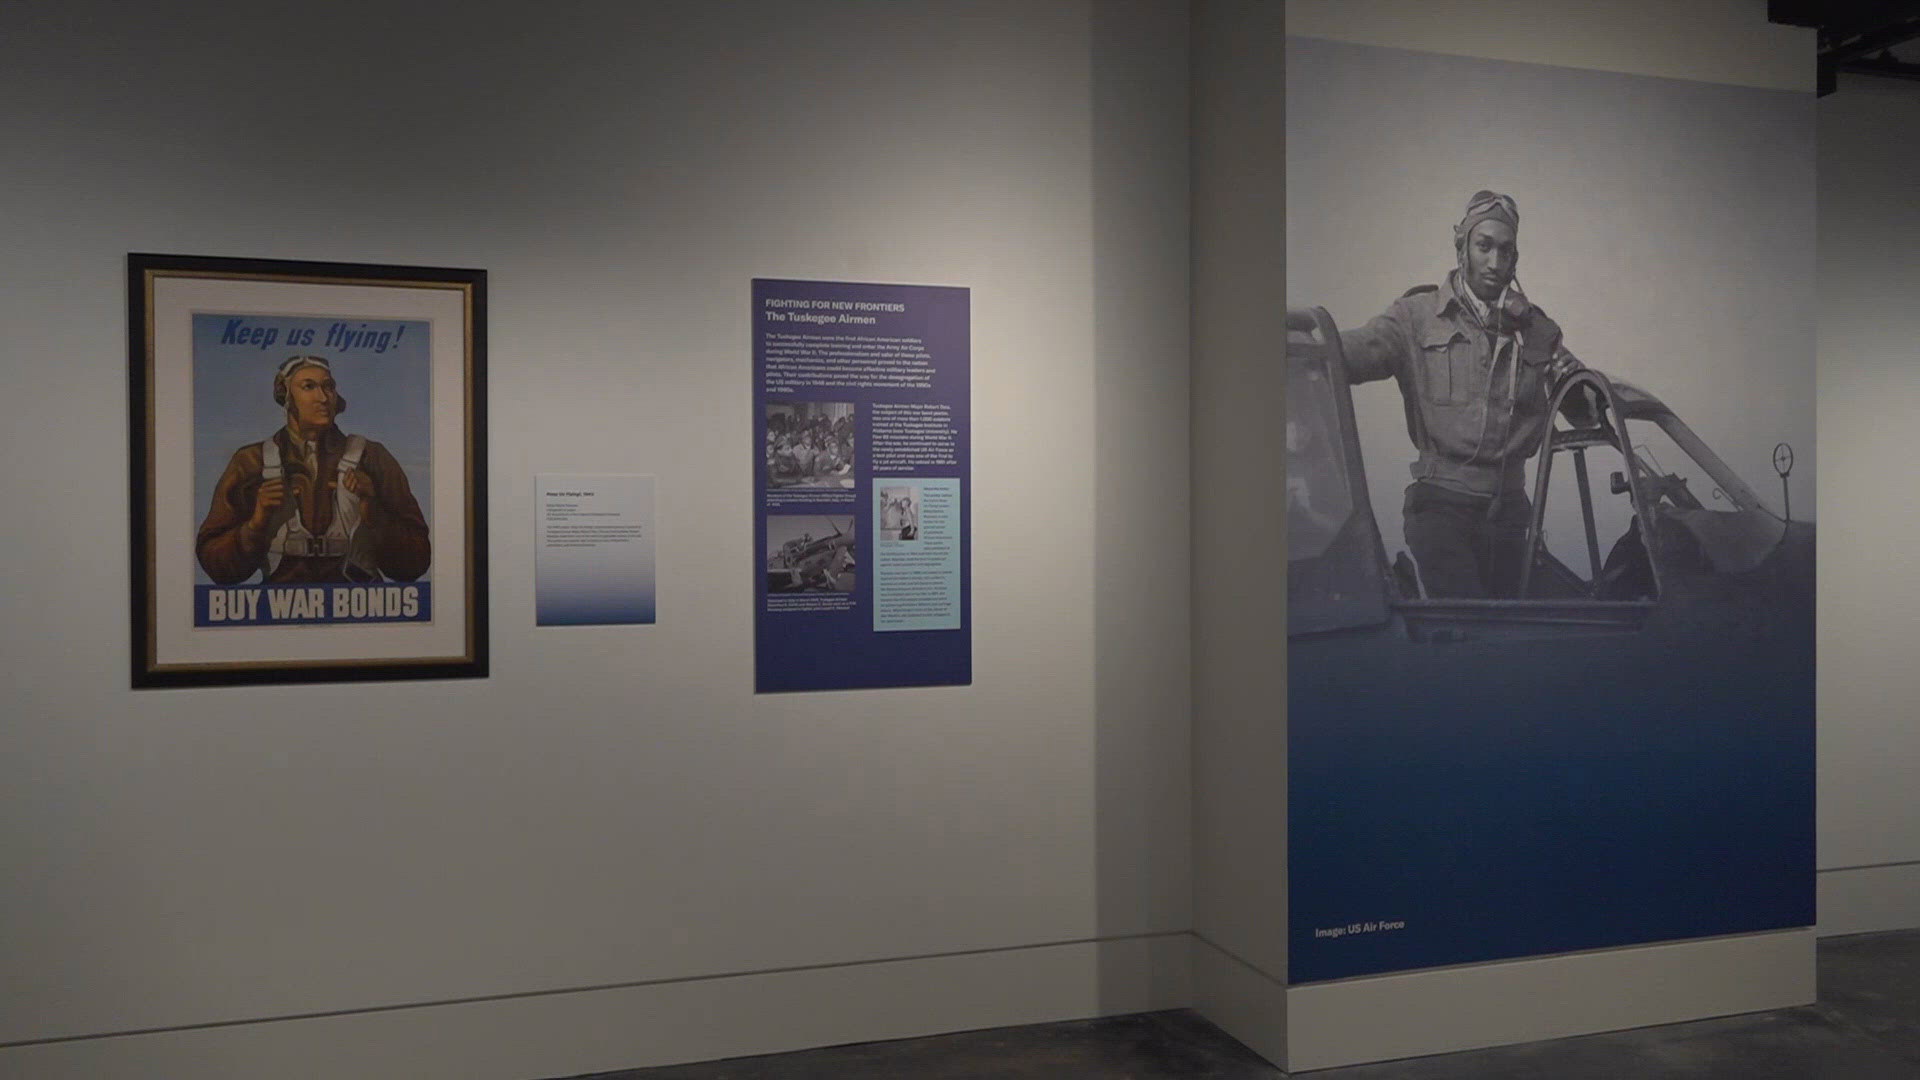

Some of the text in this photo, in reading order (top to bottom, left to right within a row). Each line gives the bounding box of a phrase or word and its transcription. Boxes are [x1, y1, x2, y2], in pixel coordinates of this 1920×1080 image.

[766, 299, 905, 313] FIGHTING FOR NEW FRONTIERS
[766, 311, 876, 325] The Tuskegee Airmen
[221, 319, 405, 353] Keep us flying!
[209, 586, 419, 621] BUY WAR BONDS
[1315, 921, 1405, 938] Image: US Air Force
